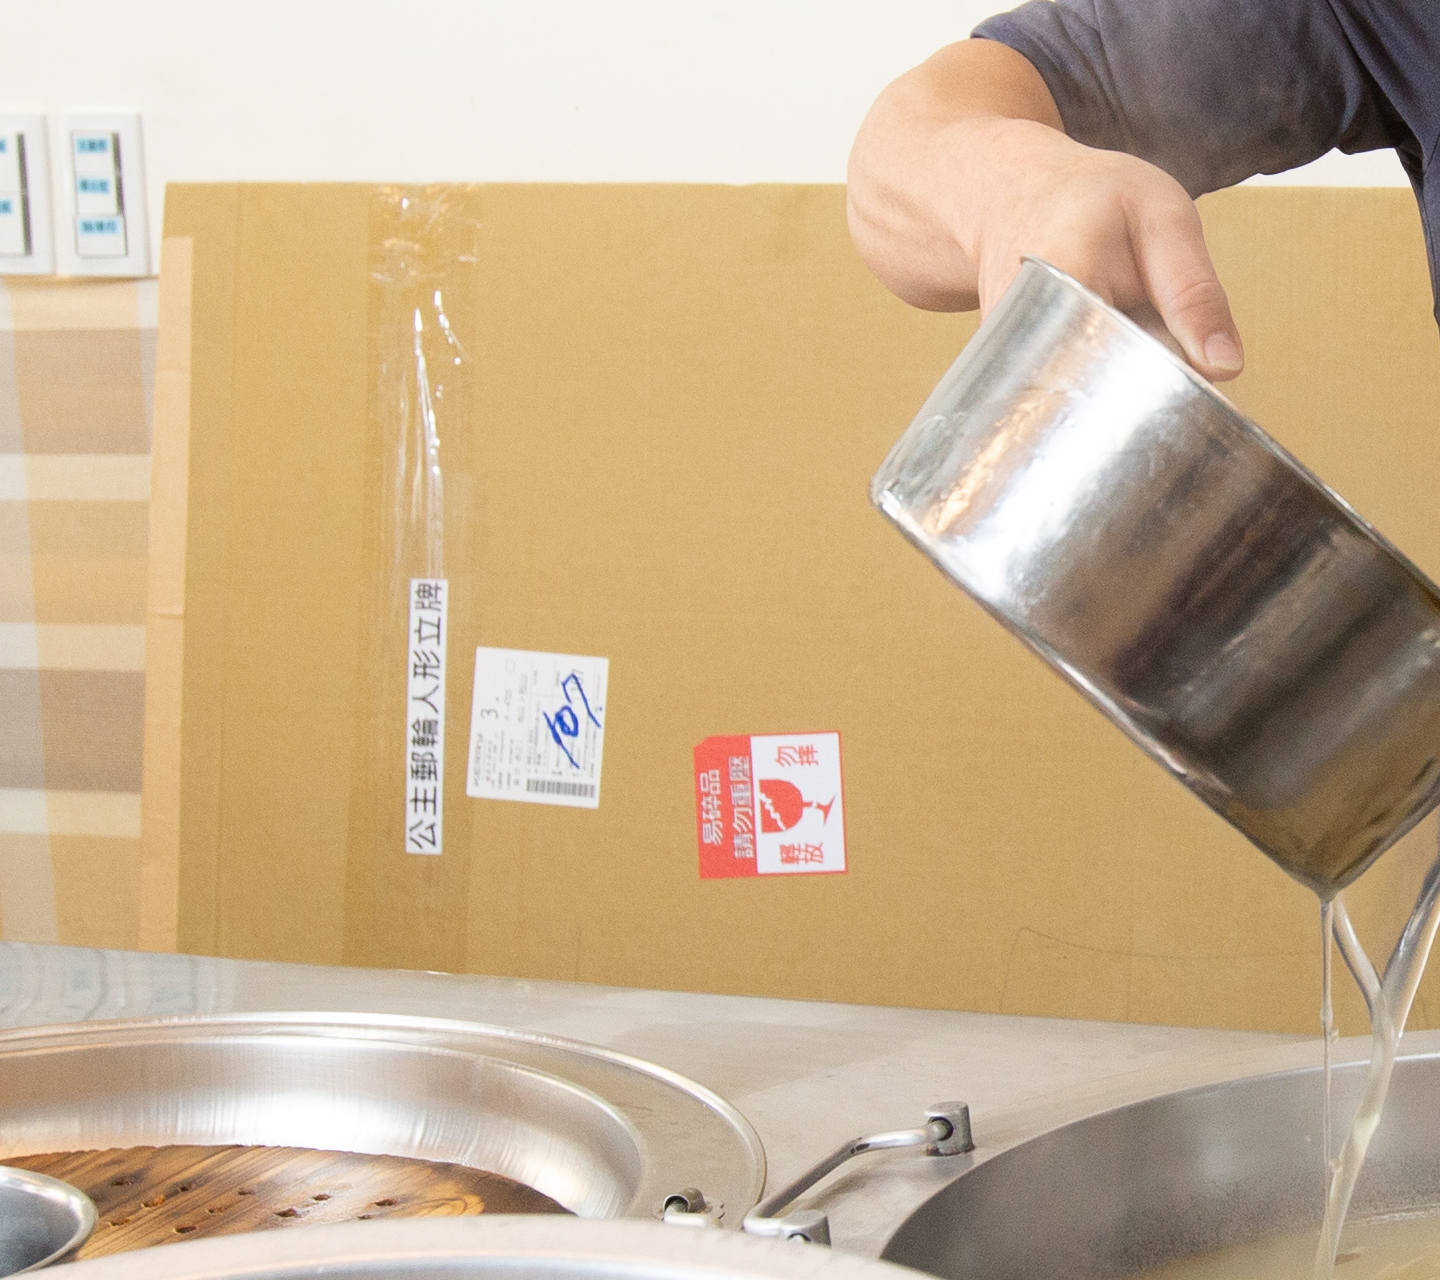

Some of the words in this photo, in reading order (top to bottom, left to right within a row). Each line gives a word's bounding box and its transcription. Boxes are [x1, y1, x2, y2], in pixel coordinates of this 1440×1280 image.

[408, 581, 444, 850] 公主郵輪人形立牌
[774, 744, 820, 768] 勿摔
[699, 769, 724, 847] 易碎品
[728, 756, 754, 860] 請勿重壓
[779, 842, 825, 866] 輕放
